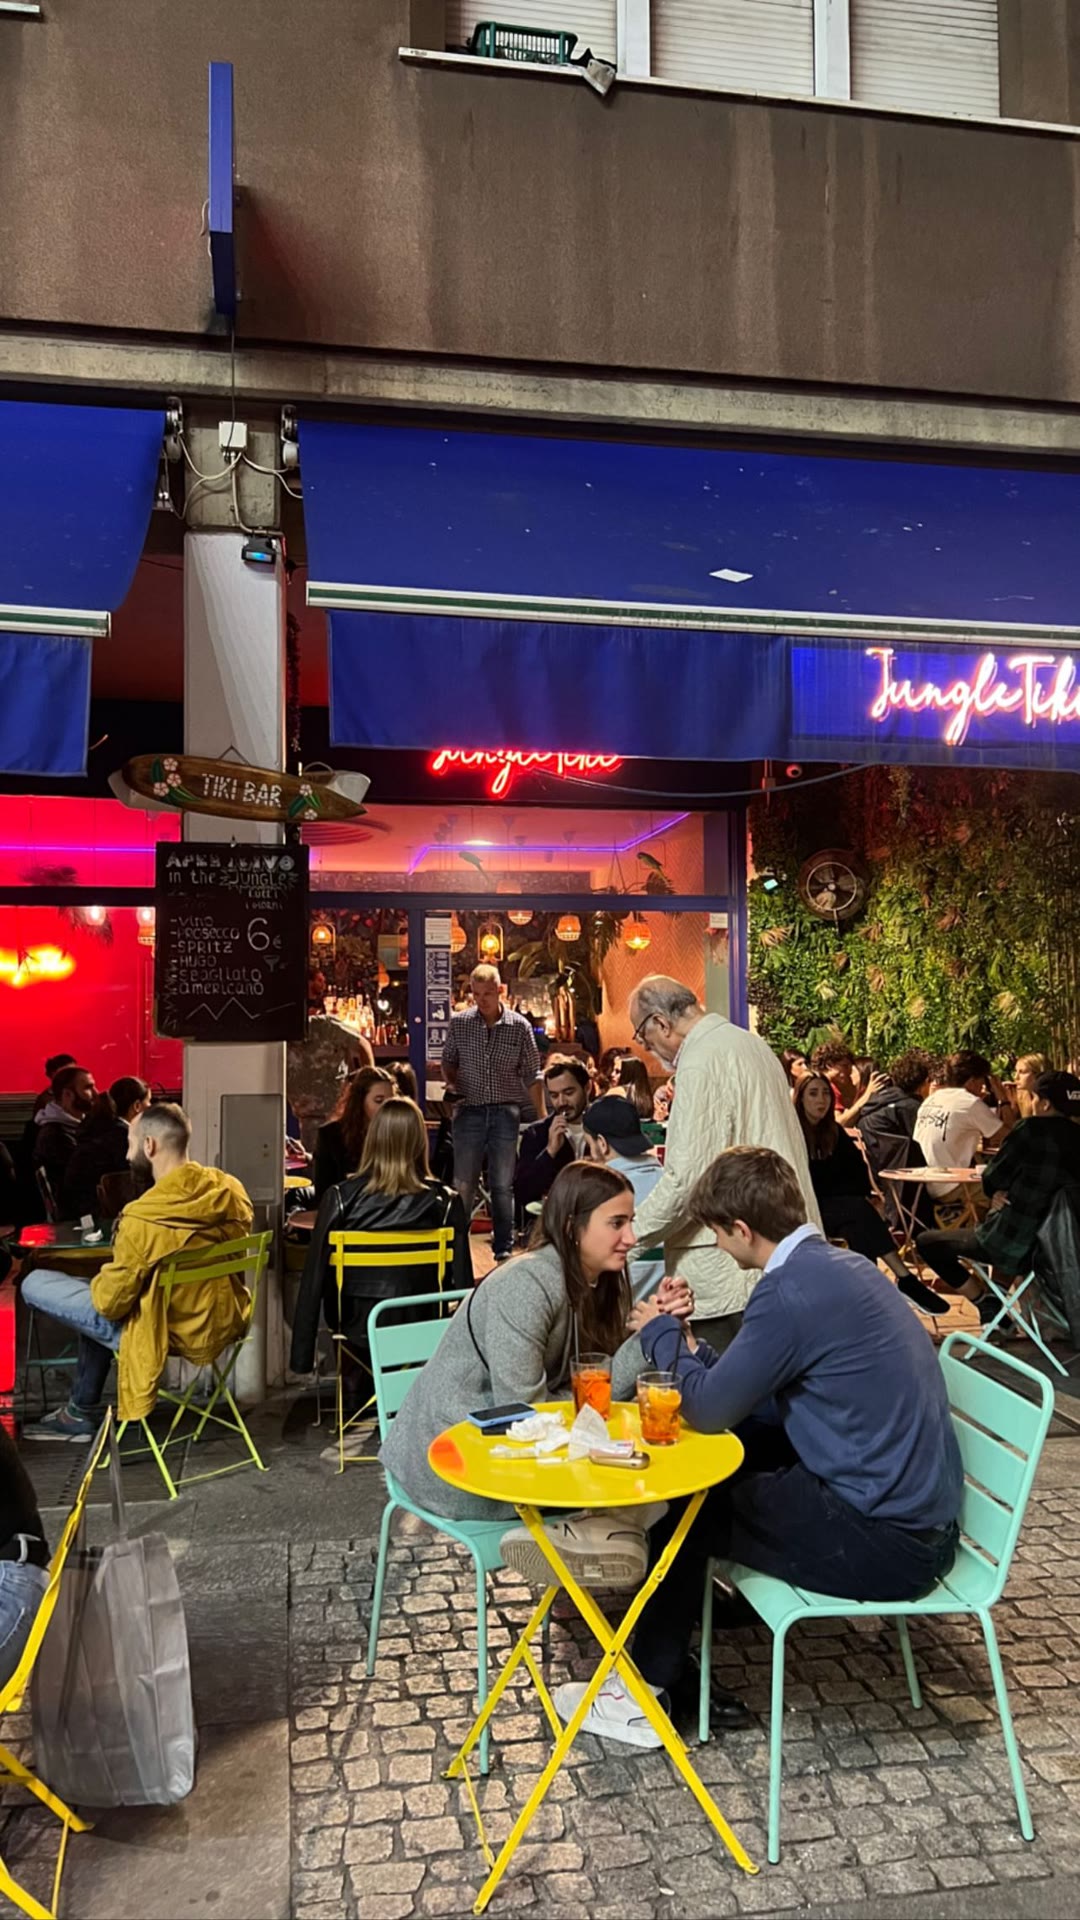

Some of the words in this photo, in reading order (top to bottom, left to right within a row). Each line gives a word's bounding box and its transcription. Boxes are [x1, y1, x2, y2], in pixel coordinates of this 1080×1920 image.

[202, 773, 238, 800] TIKI
[242, 781, 282, 808] BAR
[190, 869, 217, 884] the
